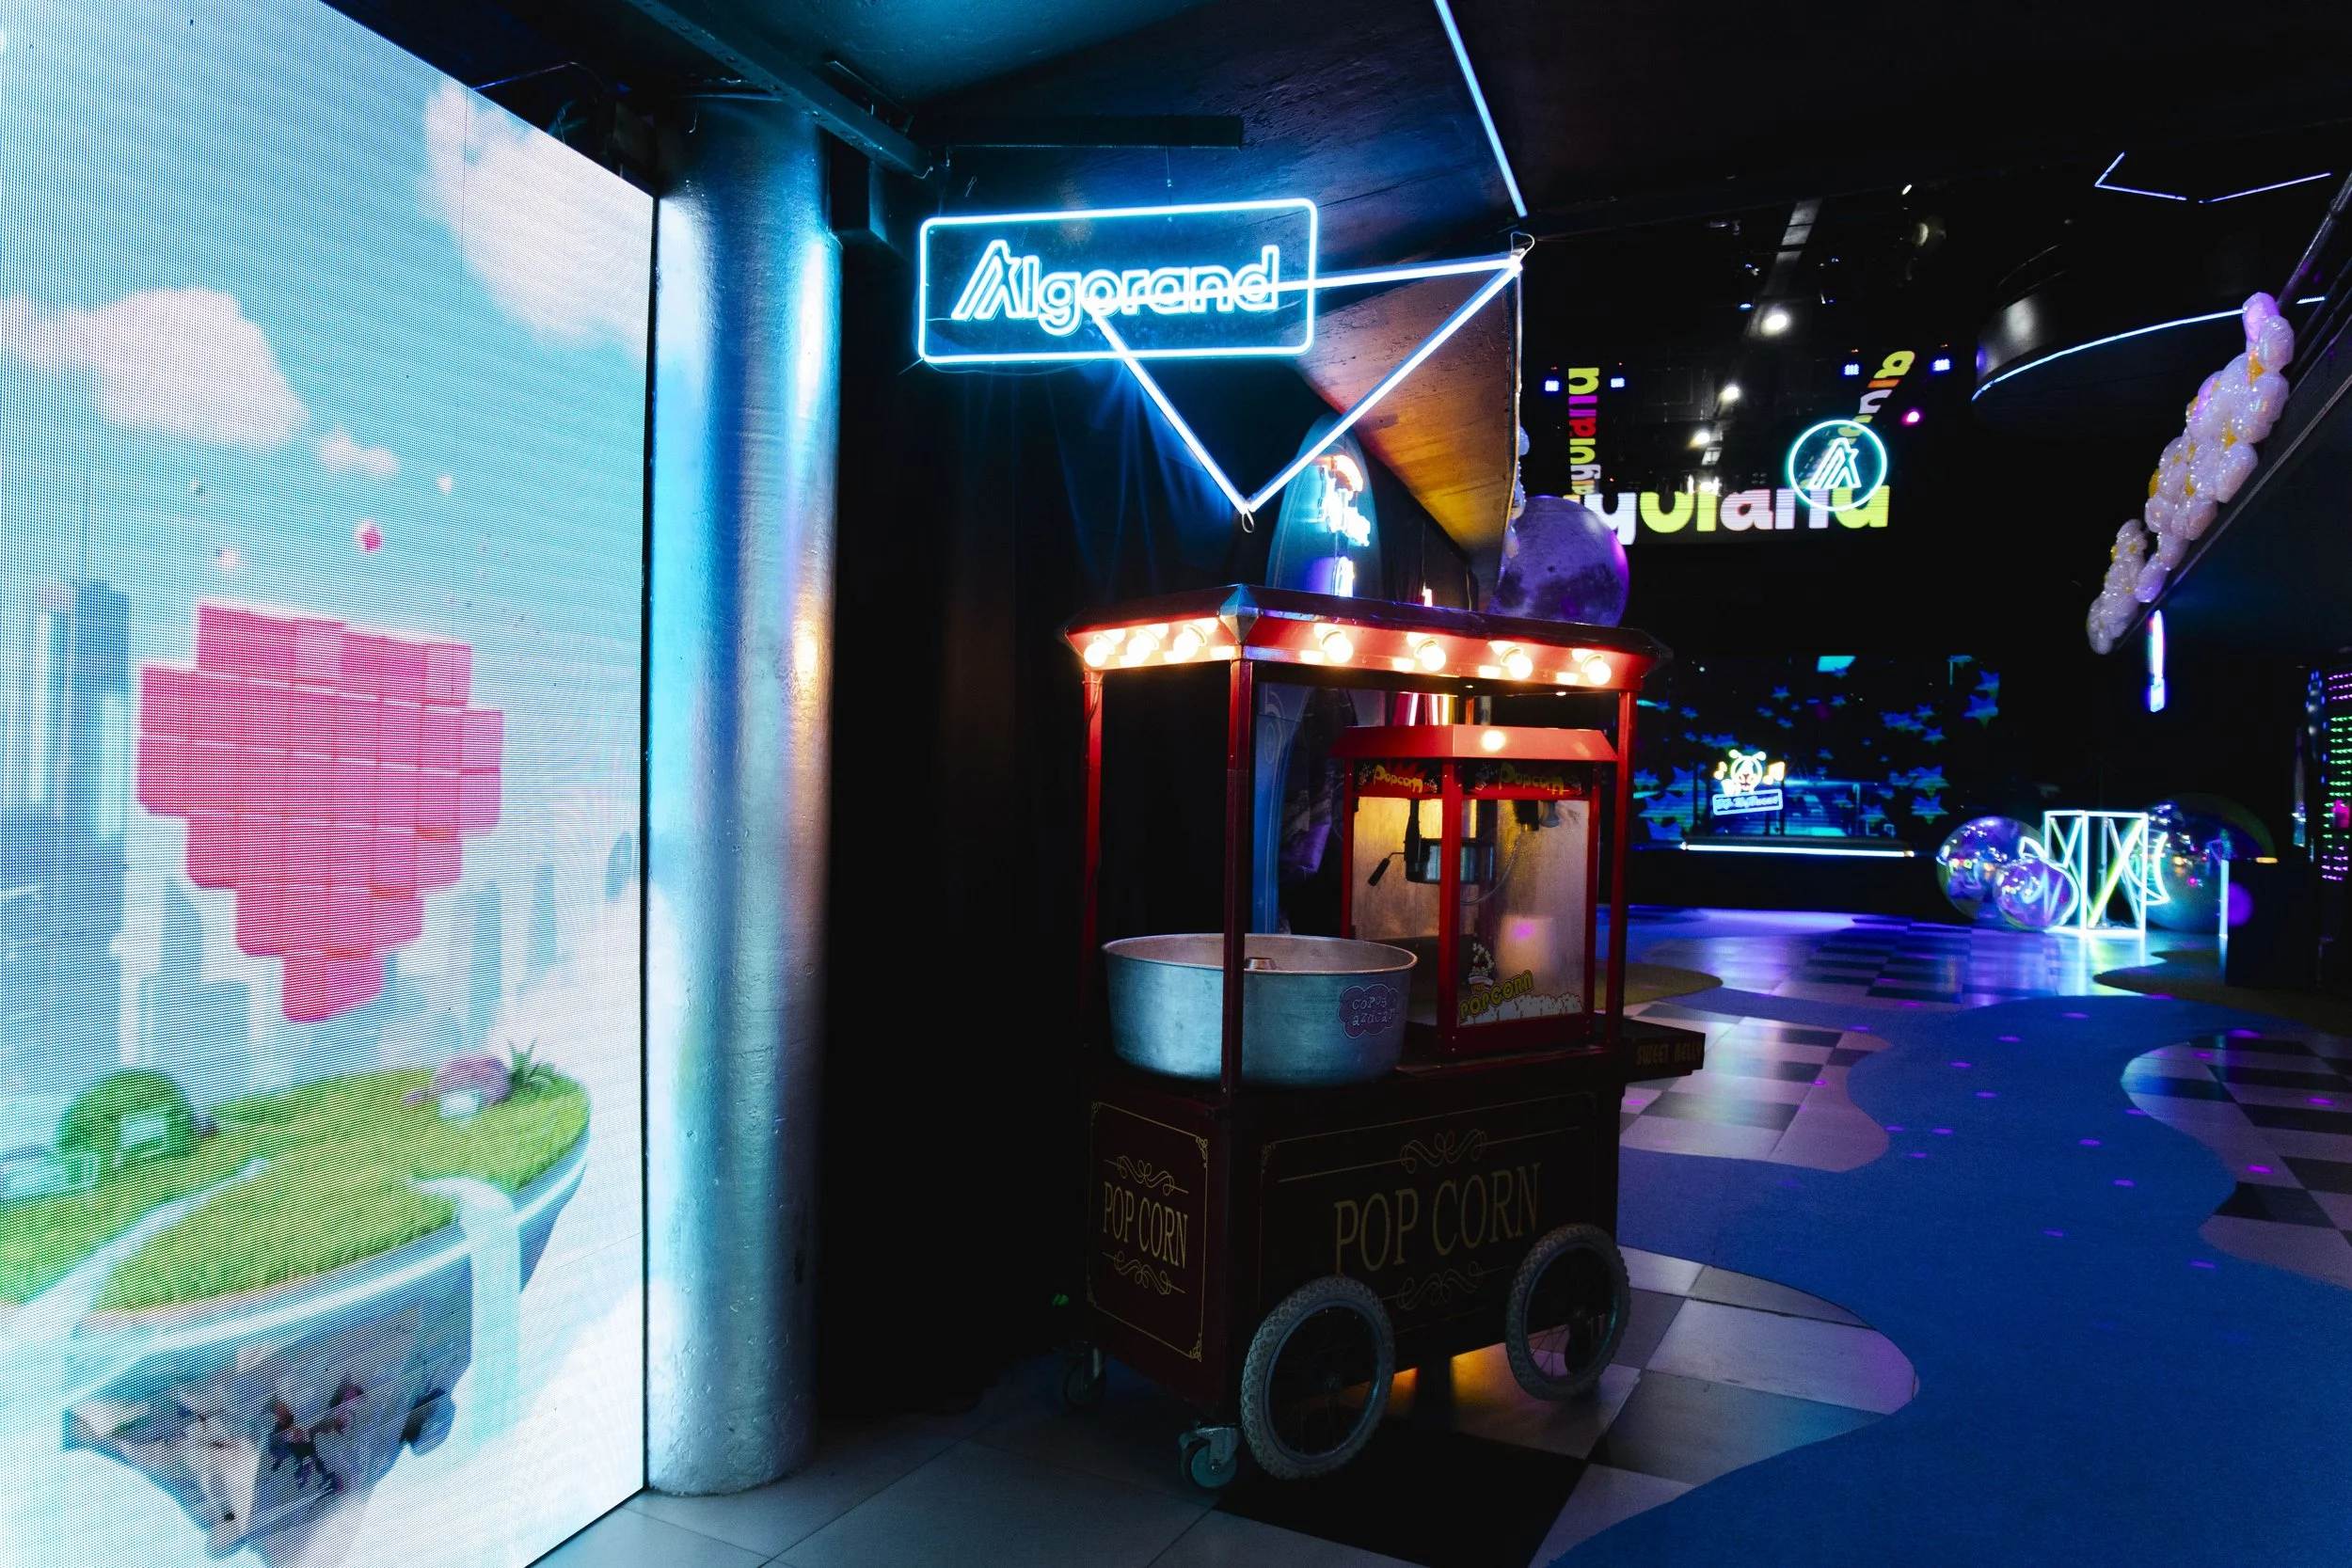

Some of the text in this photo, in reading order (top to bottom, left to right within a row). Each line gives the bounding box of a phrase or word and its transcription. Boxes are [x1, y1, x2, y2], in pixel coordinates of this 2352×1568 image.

[952, 239, 1280, 337] Algorand
[1373, 764, 1423, 793] Popcorn
[1459, 970, 1534, 1022] POPCORN
[1103, 1180, 1188, 1270] POP CORN
[1333, 1162, 1541, 1275] POP CORN
